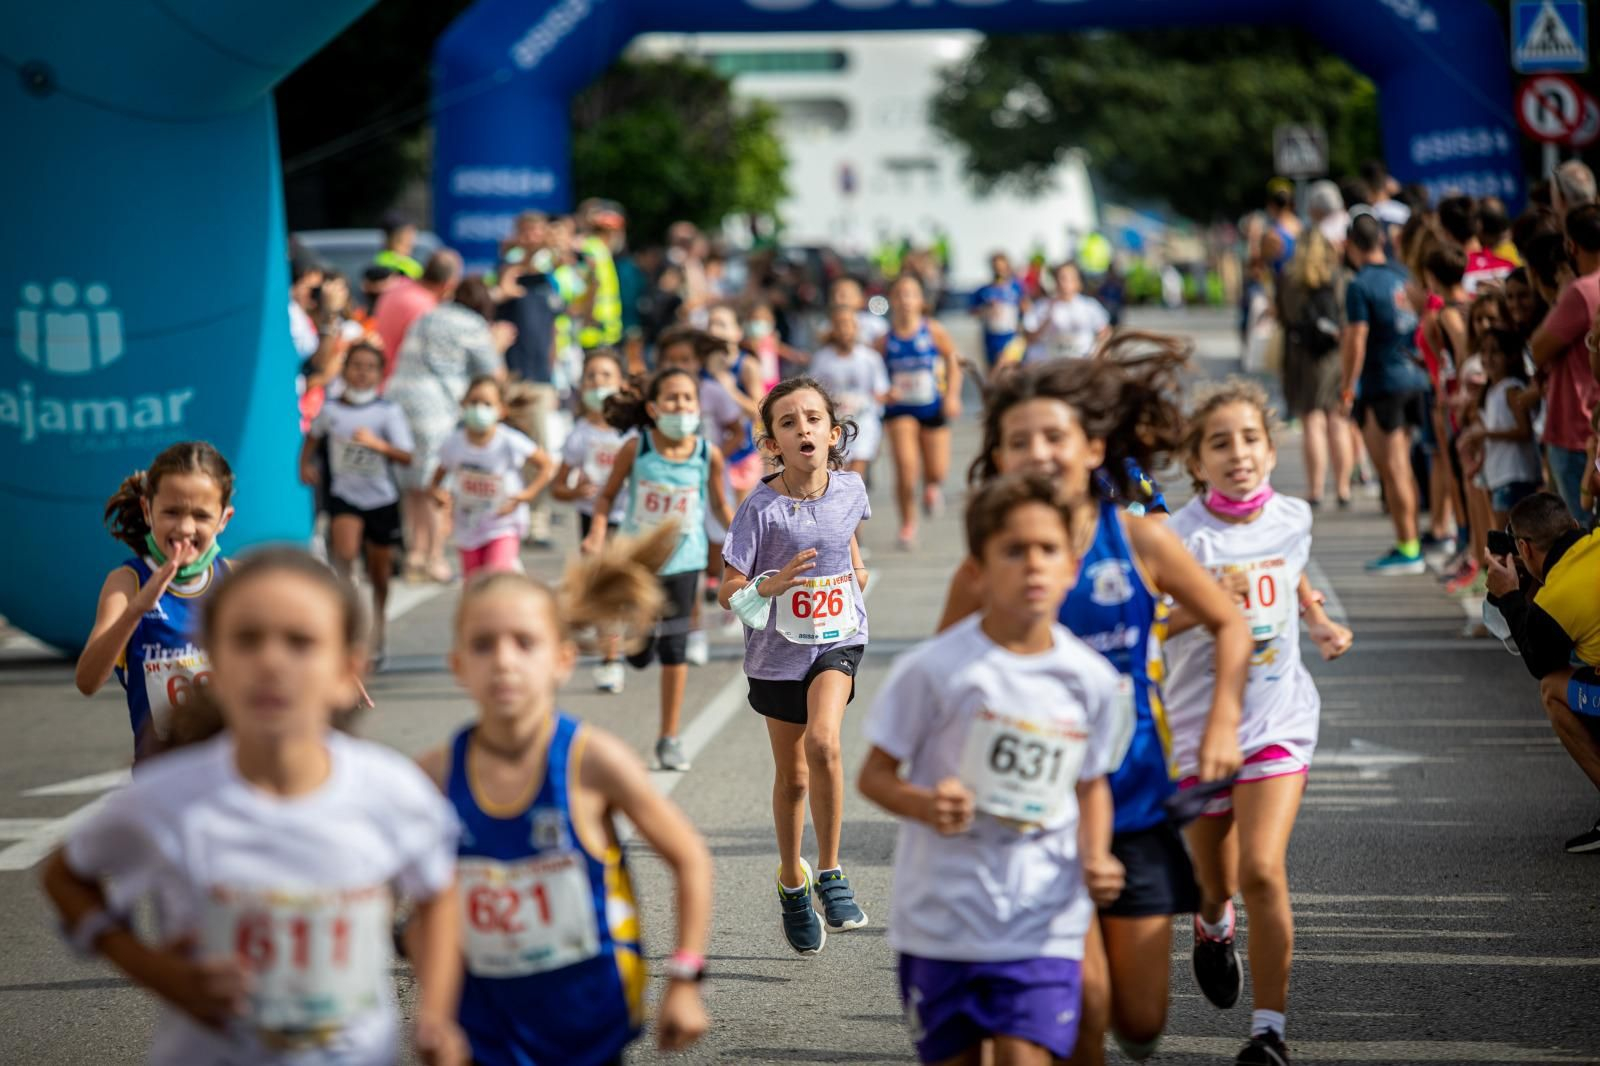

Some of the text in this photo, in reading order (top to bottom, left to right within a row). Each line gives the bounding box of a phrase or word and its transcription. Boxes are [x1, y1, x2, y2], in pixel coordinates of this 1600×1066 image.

[644, 493, 688, 514] 614
[791, 588, 843, 618] 626
[987, 733, 1063, 785] 631
[466, 880, 555, 933] 621
[236, 912, 350, 973] 611
